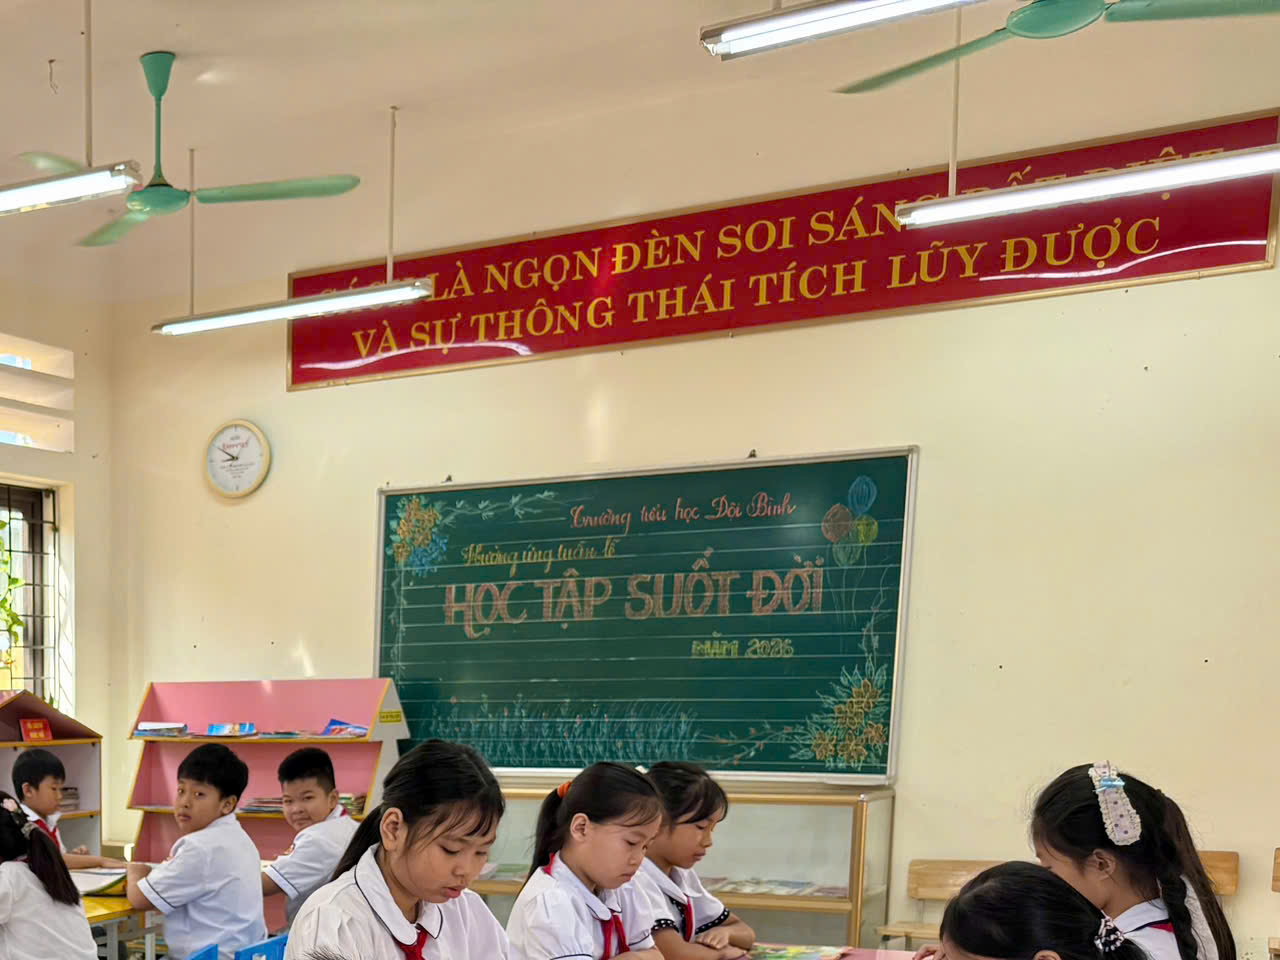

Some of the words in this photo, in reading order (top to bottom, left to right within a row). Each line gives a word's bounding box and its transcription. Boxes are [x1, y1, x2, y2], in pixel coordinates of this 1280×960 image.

[352, 320, 399, 358] VÀ
[410, 313, 458, 355] SỰ
[470, 297, 614, 343] THÔNG
[628, 273, 736, 325] THÁI
[749, 260, 867, 307] TÍCH
[887, 241, 987, 289] LŨY
[1000, 217, 1161, 273] ĐƯỢC
[426, 261, 474, 301] LÀ
[483, 247, 601, 292] NGỌN
[611, 229, 706, 275] ĐÈN
[716, 216, 795, 259] SOI
[808, 193, 940, 246] SÁN
[675, 498, 700, 524] học
[534, 568, 613, 630] TẬP
